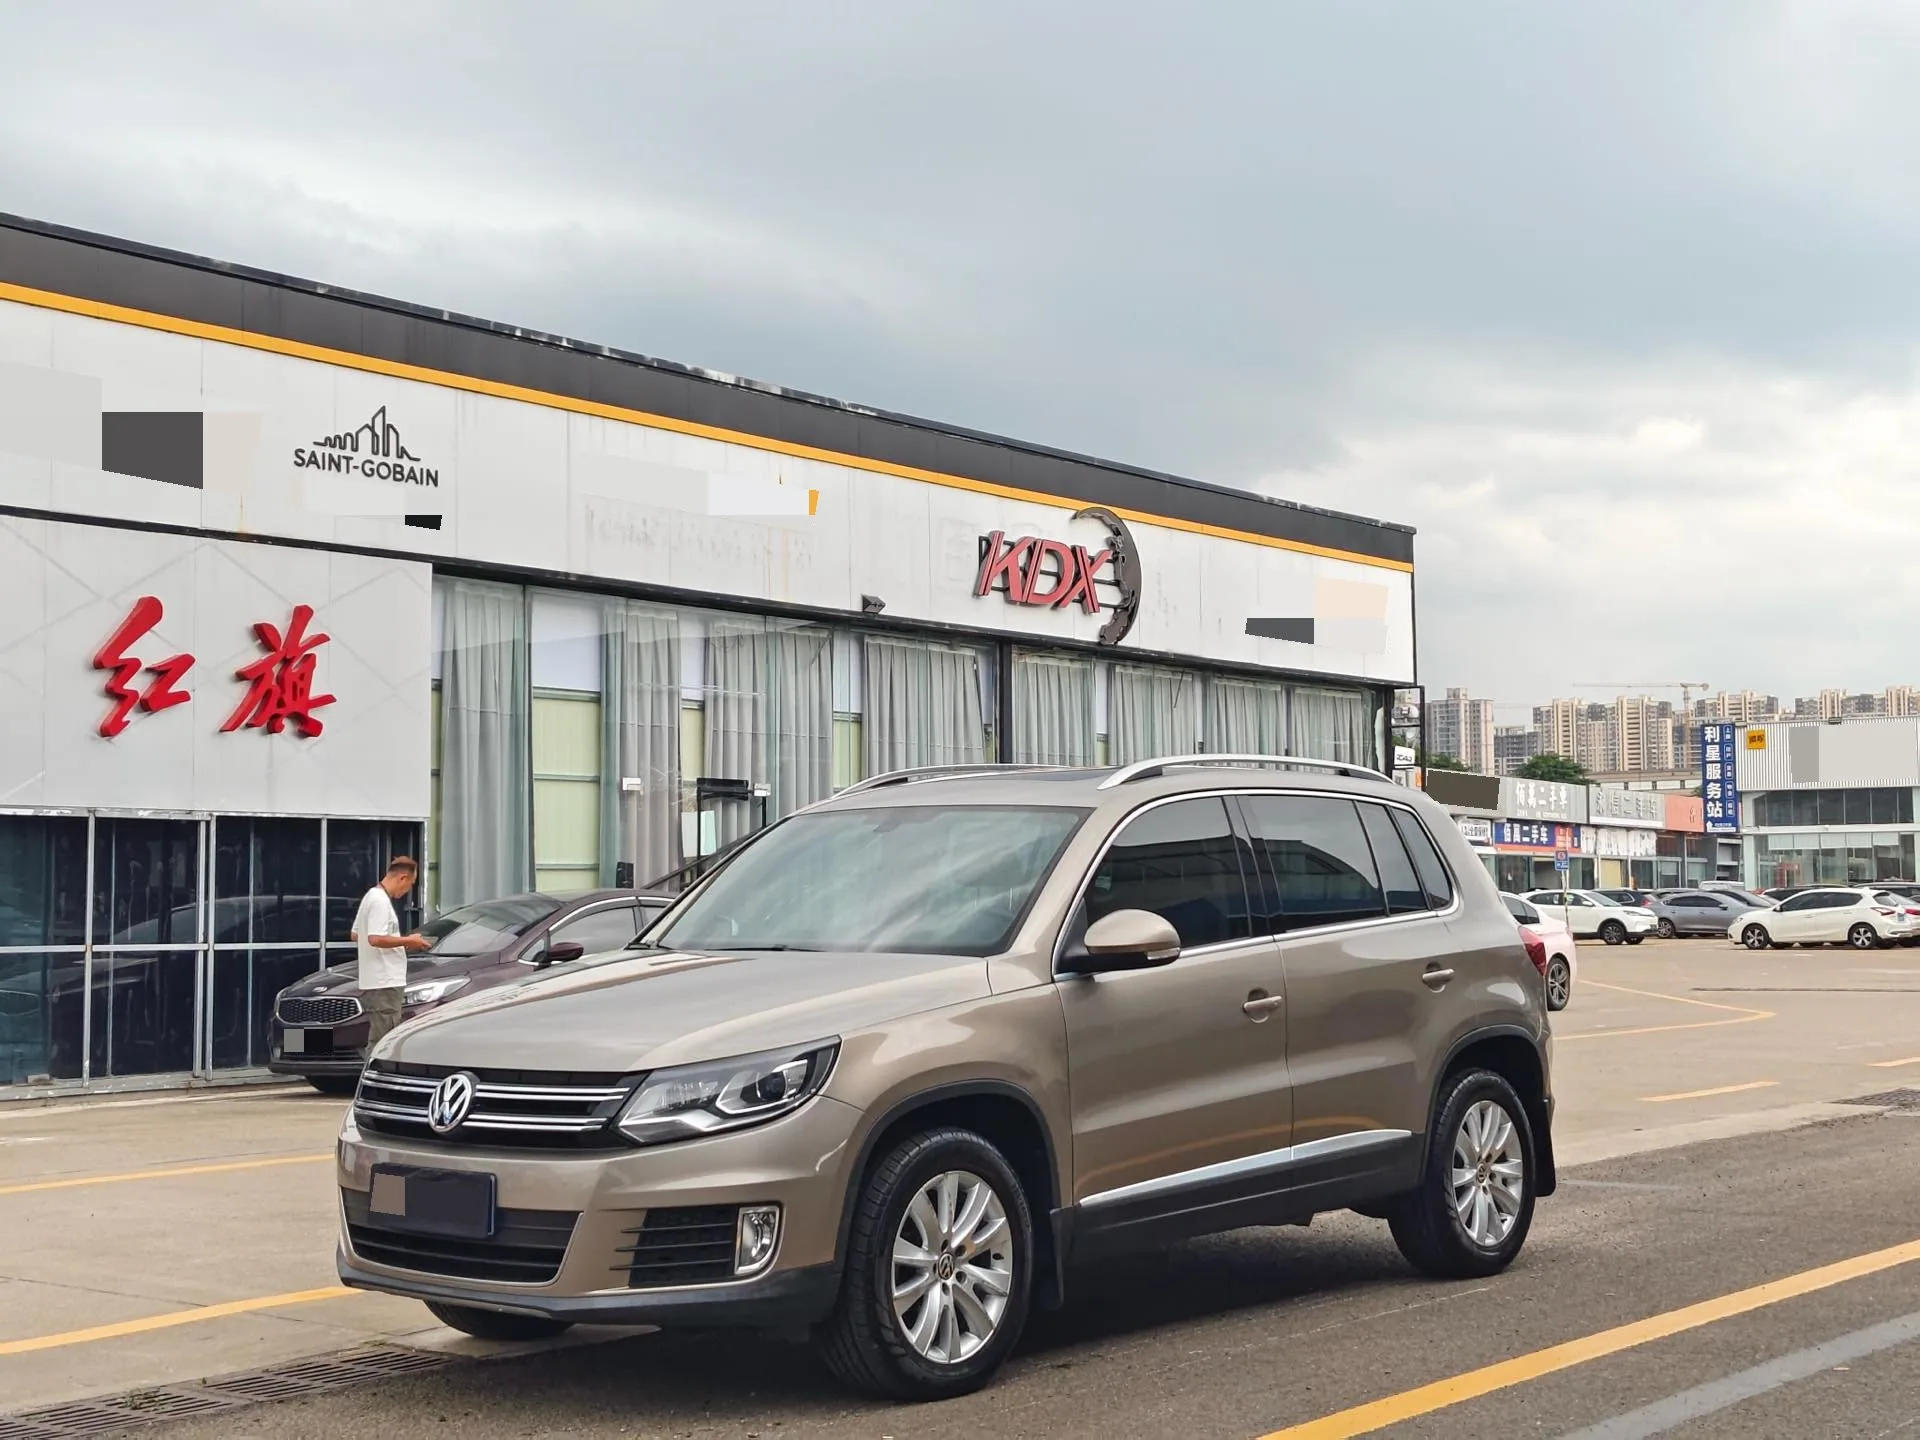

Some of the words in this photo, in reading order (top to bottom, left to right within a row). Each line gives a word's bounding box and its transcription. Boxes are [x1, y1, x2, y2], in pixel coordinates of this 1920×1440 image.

[294, 448, 438, 487] SAINT-GOBAIN
[976, 530, 1112, 613] KDX
[92, 595, 338, 739] 红旗
[1704, 725, 1723, 818] 利星服务站
